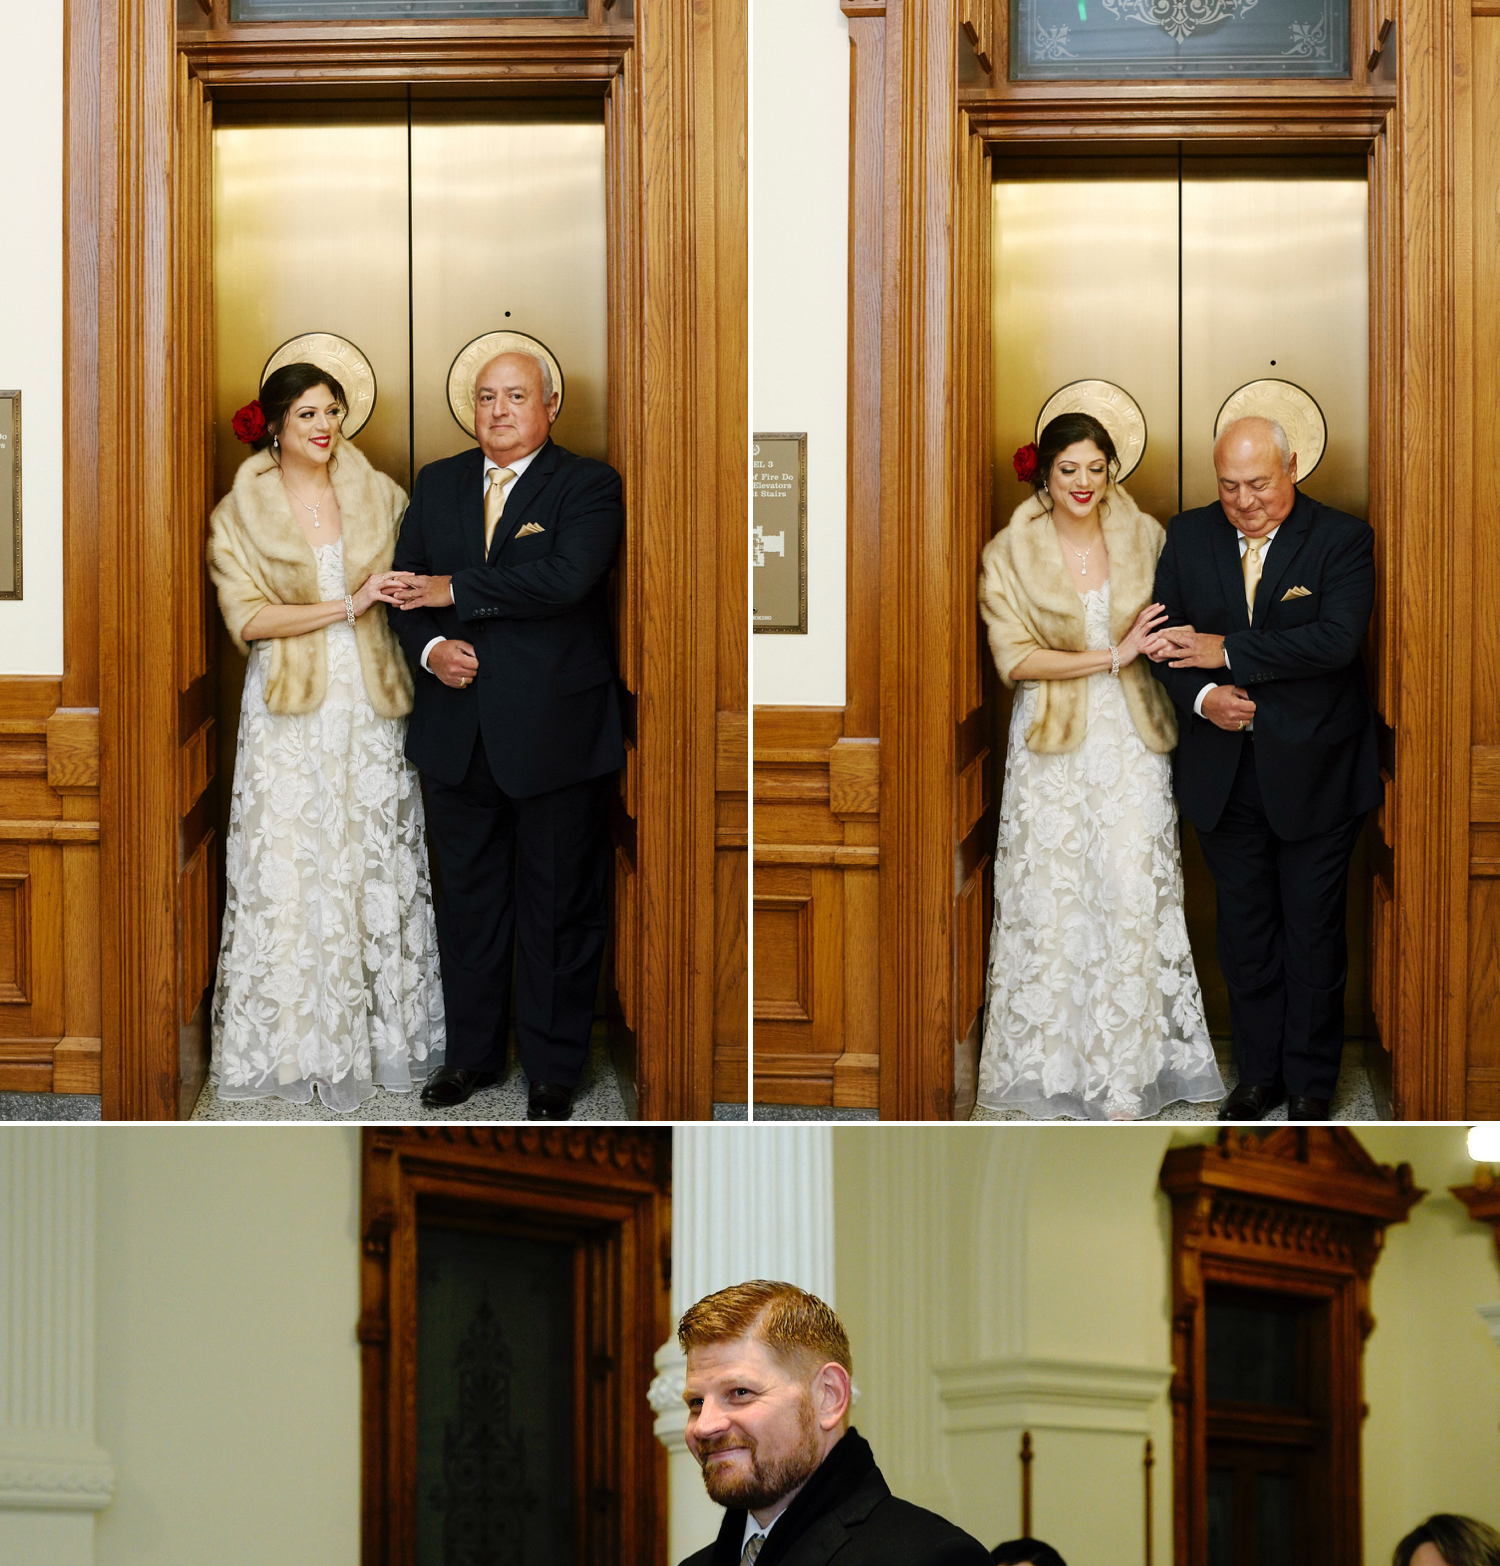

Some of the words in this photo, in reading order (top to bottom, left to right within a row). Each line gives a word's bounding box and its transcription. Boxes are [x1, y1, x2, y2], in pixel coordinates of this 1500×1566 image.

[325, 340, 349, 357] OF
[454, 379, 468, 414] THE
[461, 339, 505, 370] STATE
[1099, 387, 1122, 402] OF
[1228, 386, 1271, 417] STATE
[1279, 387, 1301, 402] OF
